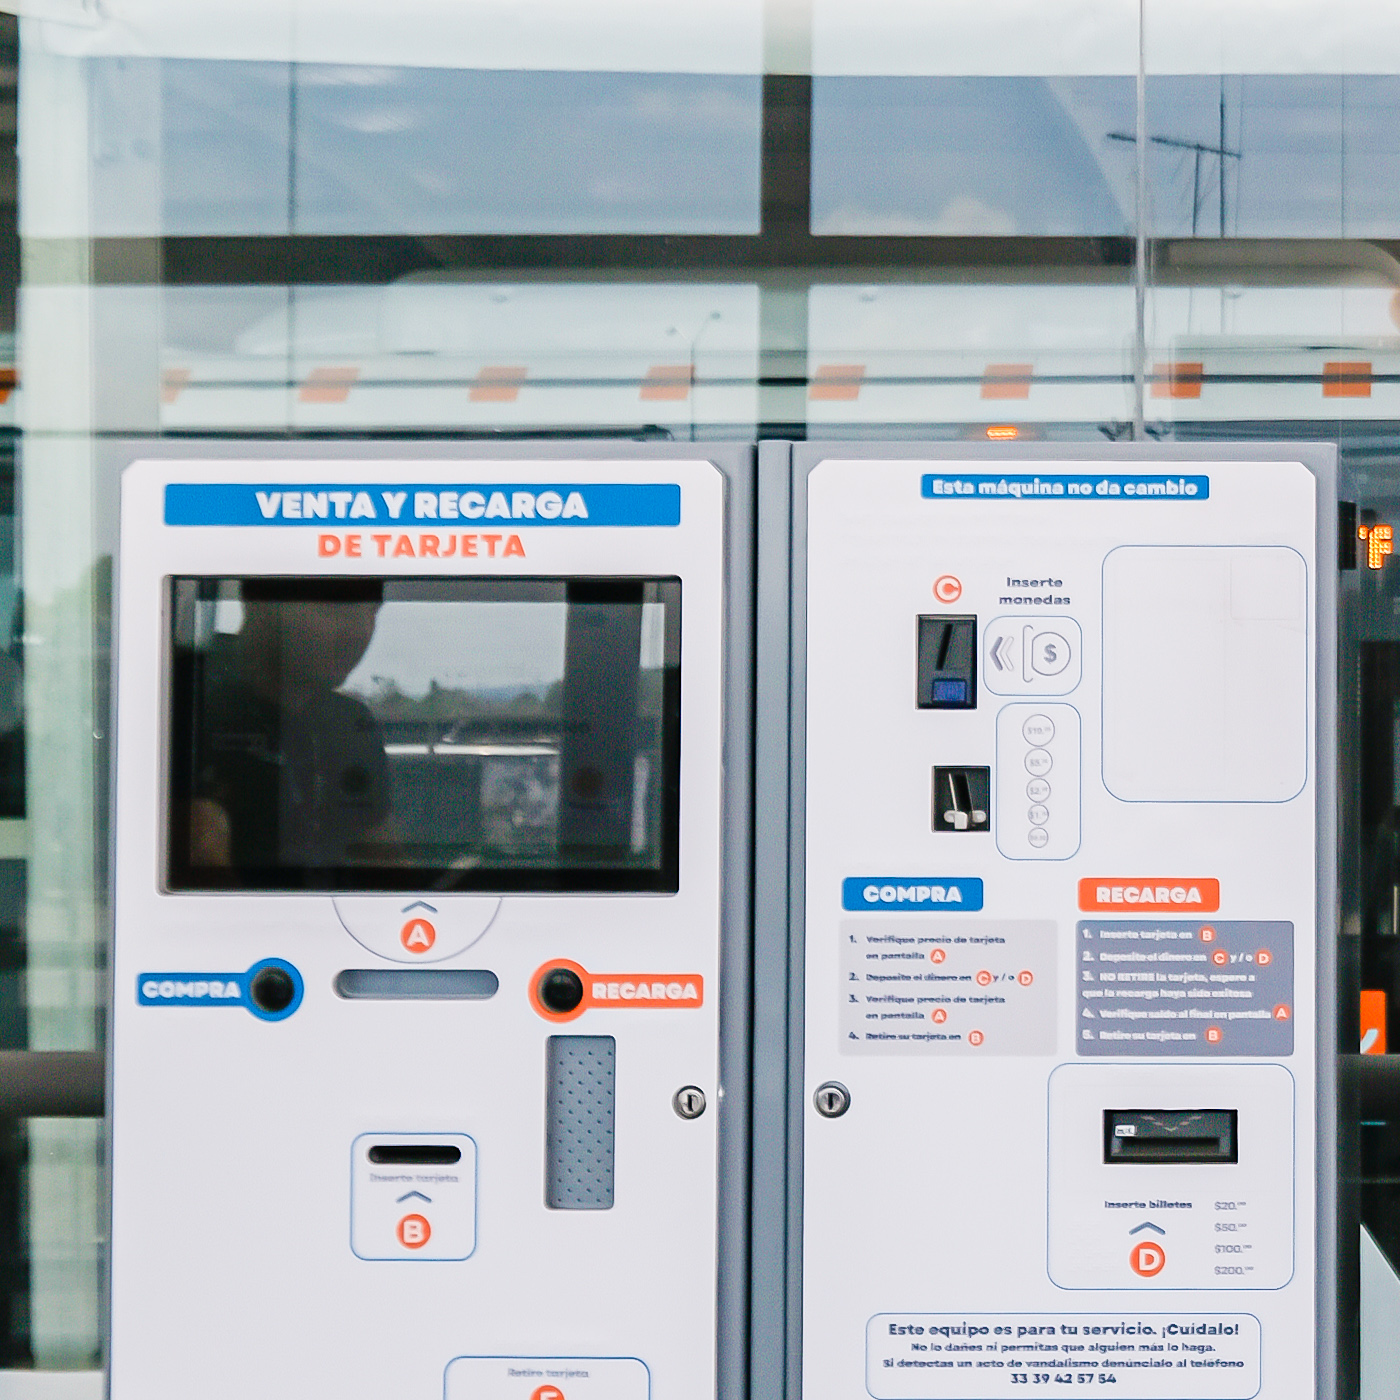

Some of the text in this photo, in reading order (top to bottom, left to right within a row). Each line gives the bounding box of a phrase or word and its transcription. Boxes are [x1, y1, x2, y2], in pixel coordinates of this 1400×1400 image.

[933, 477, 1198, 498] Esta máquina no da cambio
[256, 491, 588, 519] VENTA Y RECARGA
[318, 534, 525, 557] DE TARJETA
[1007, 577, 1063, 587] Inserte
[1000, 595, 1070, 604] monedas
[863, 885, 962, 902] COMPRA
[1096, 886, 1202, 903] RECARGA
[408, 925, 429, 945] A
[142, 980, 241, 998] COMPRA
[592, 982, 698, 999] RECARGA
[1149, 1200, 1192, 1208] billetes
[403, 1220, 425, 1243] B
[1139, 1250, 1158, 1270] D
[889, 1324, 924, 1335] Este
[929, 1321, 989, 1338] equipo
[994, 1326, 1012, 1335] es
[1017, 1326, 1055, 1338] para
[1060, 1324, 1077, 1335] tu
[1083, 1322, 1157, 1335] servicio.
[1011, 1373, 1116, 1384] 33 39 42 57 54
